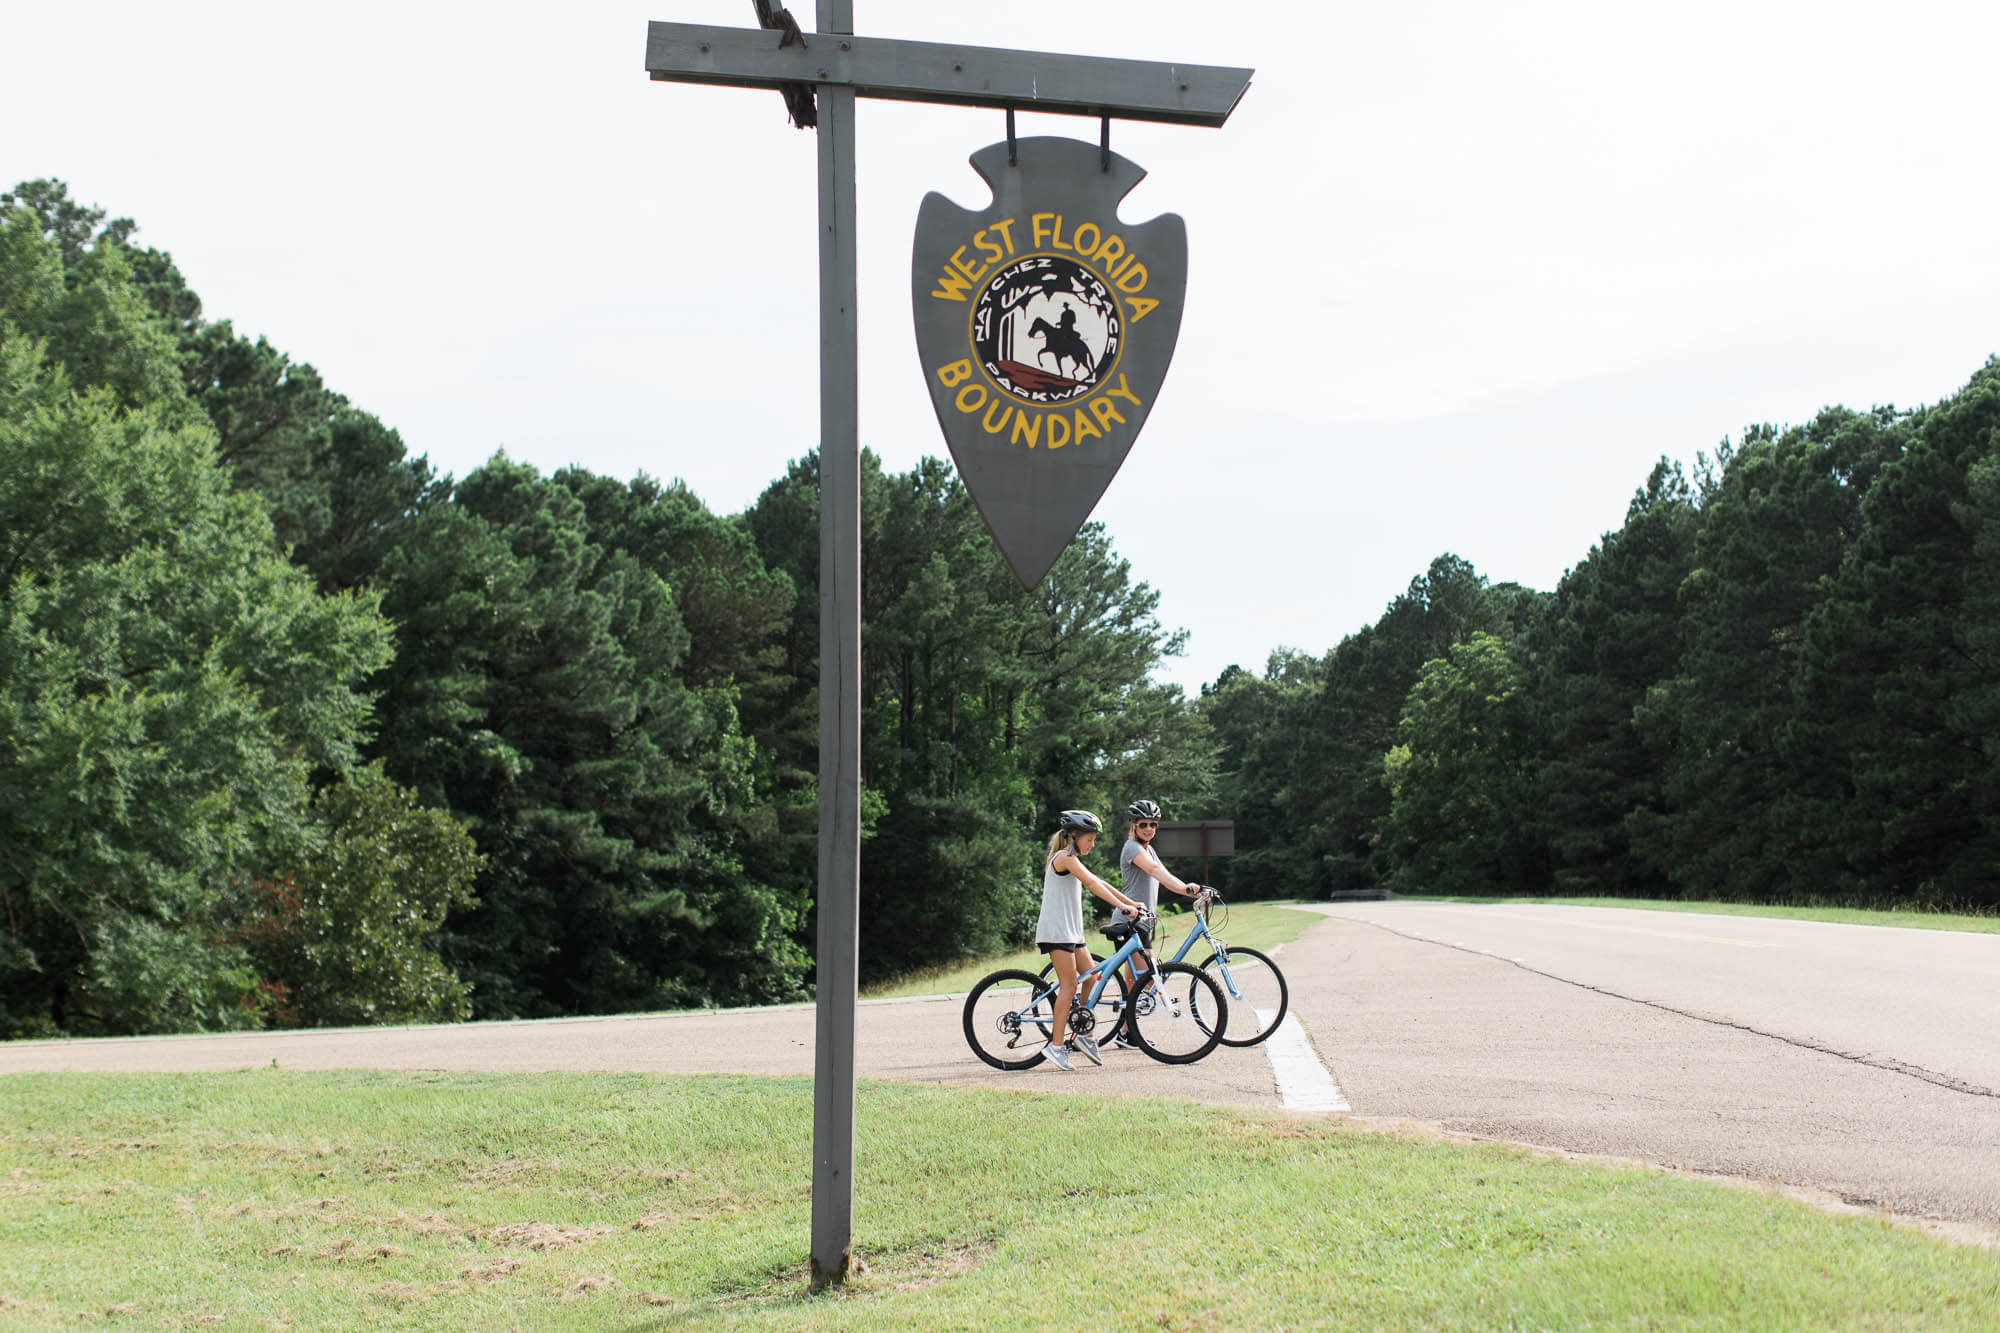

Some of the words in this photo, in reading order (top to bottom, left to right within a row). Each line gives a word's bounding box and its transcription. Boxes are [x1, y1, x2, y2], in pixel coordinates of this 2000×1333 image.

[931, 218, 1015, 301] WEST
[1031, 213, 1159, 323] FLORIDA
[975, 259, 1052, 342] NATCHEZ
[1079, 268, 1119, 354] TRACE
[937, 358, 1141, 449] BOUNDARY
[985, 362, 1096, 401] PARKWAY
